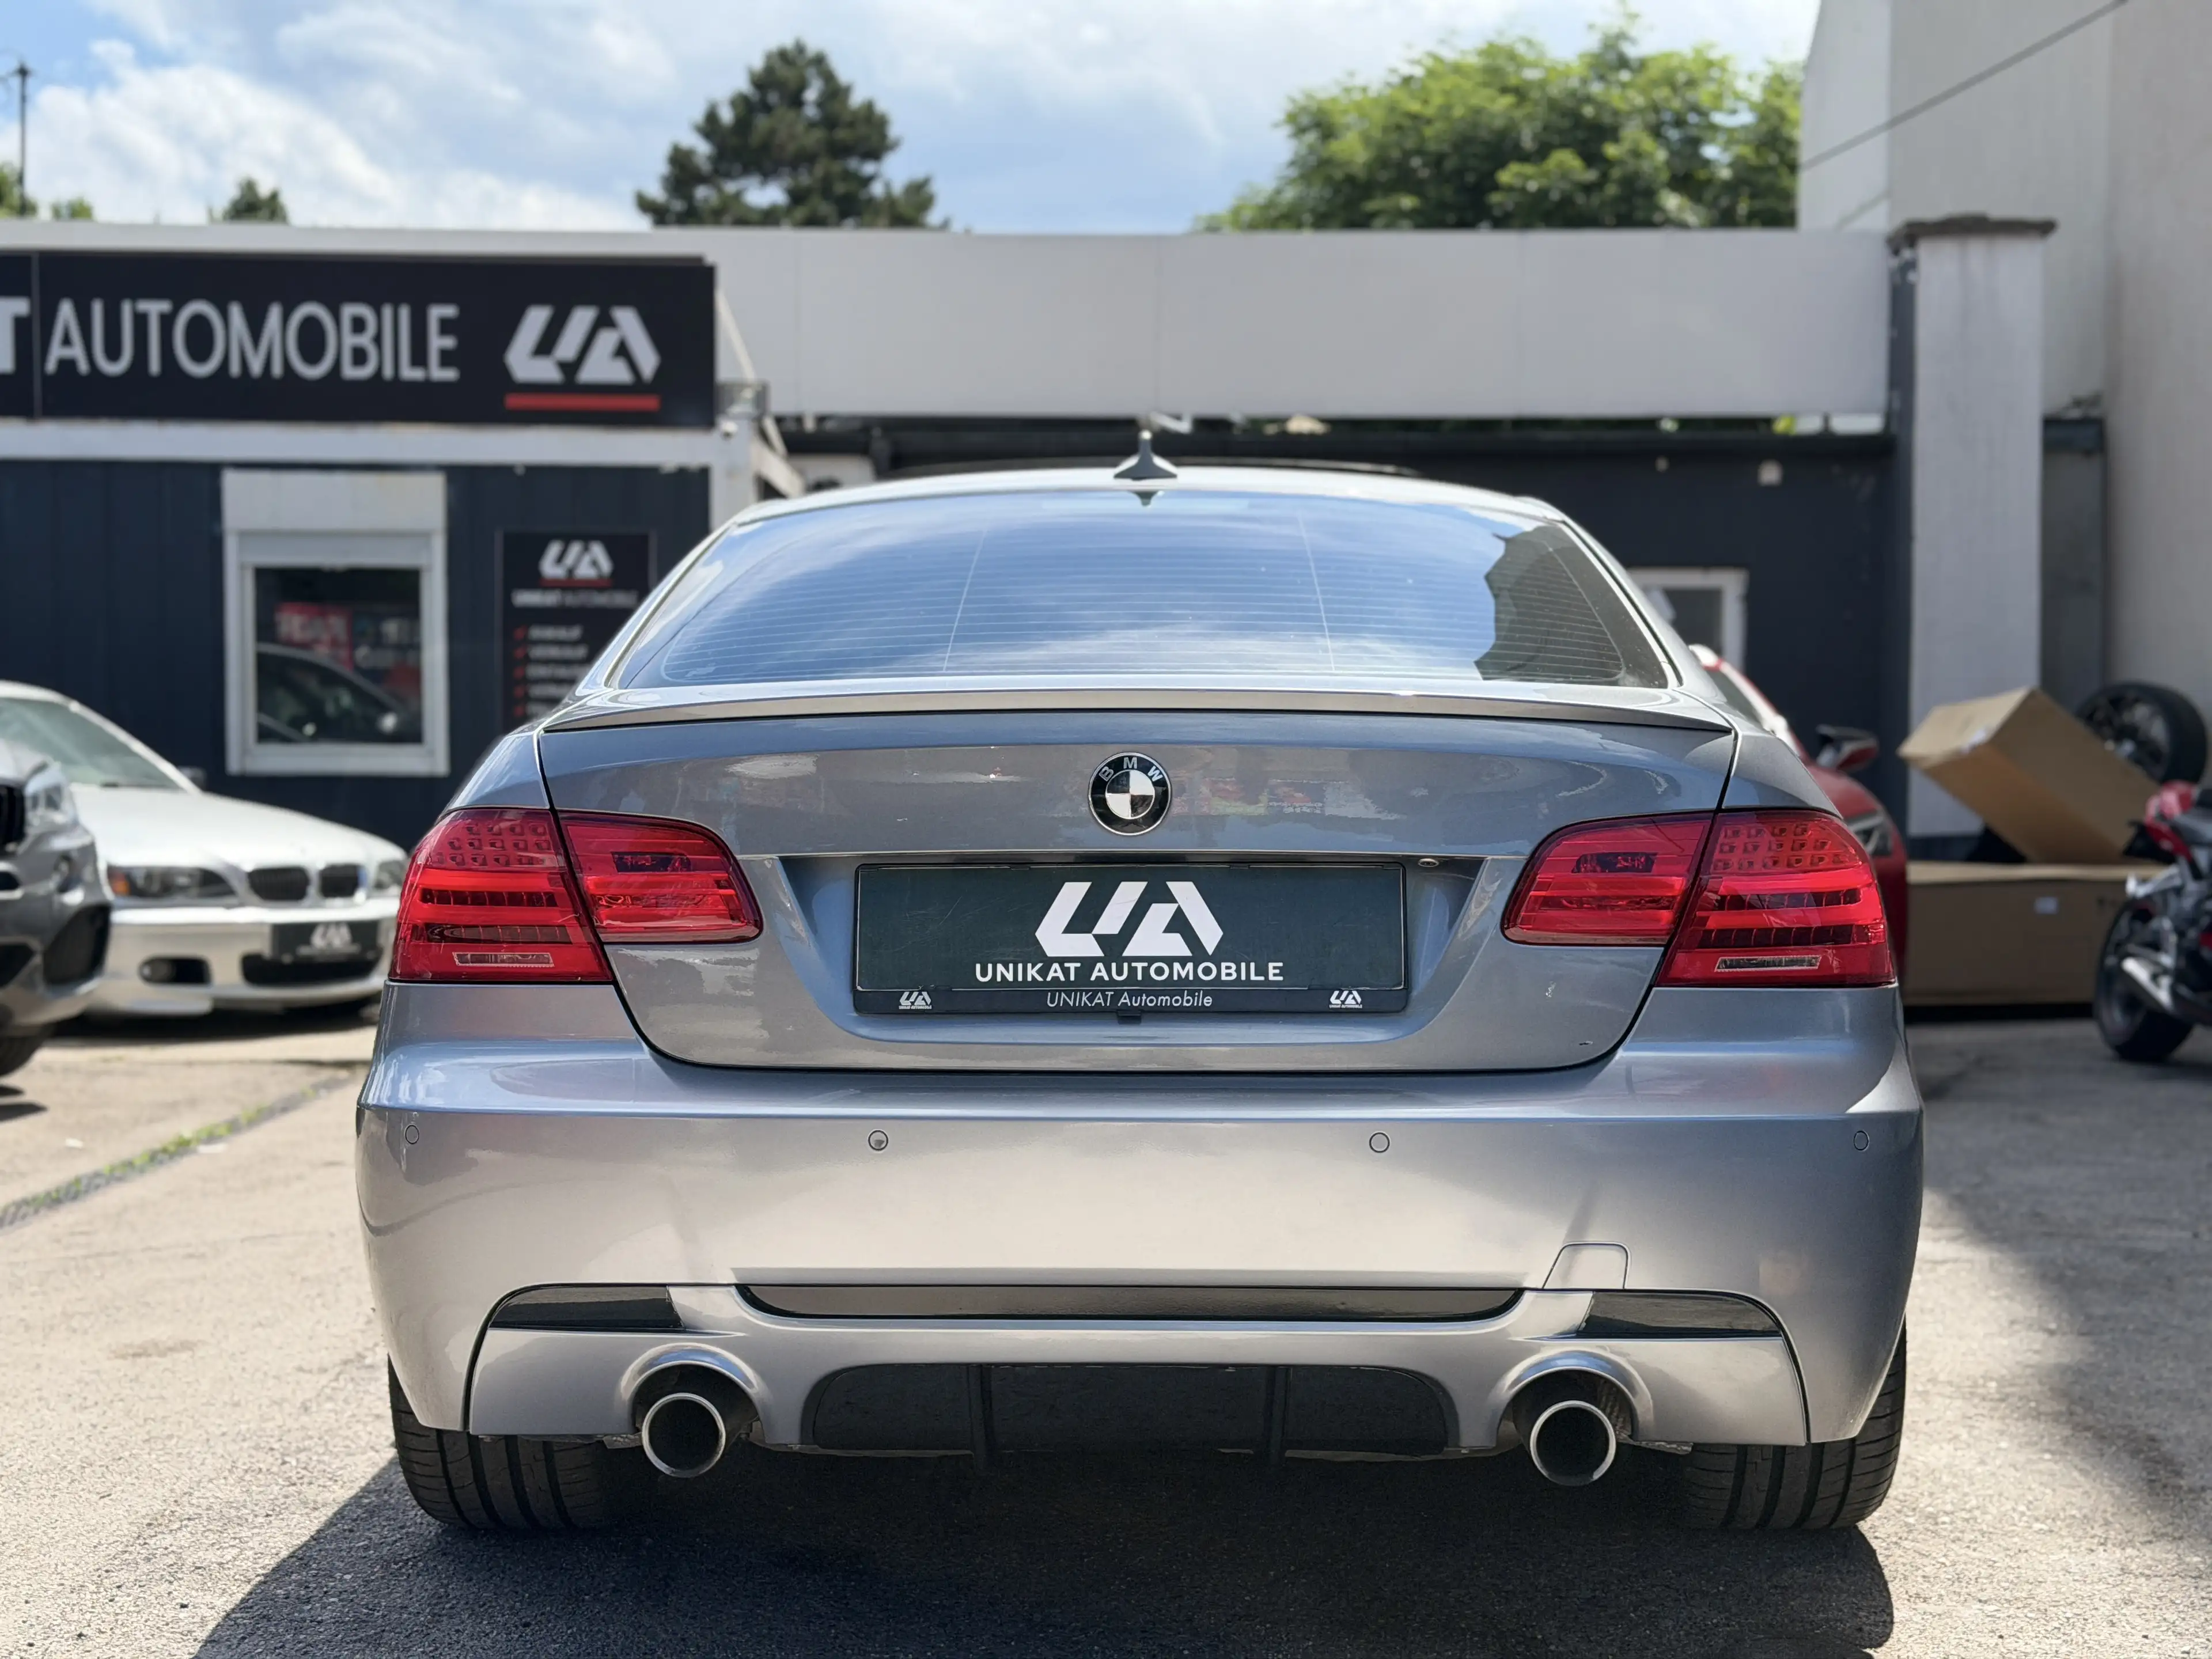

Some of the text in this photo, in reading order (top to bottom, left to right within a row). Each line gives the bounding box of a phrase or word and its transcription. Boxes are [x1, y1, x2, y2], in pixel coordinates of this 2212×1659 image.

[45, 298, 460, 382] AUTOMOBILE
[1099, 757, 1163, 782] BMW
[975, 961, 1283, 982] UNIKAT AUTOMOBILE
[1047, 990, 1213, 1007] UNIKAT Automobile
